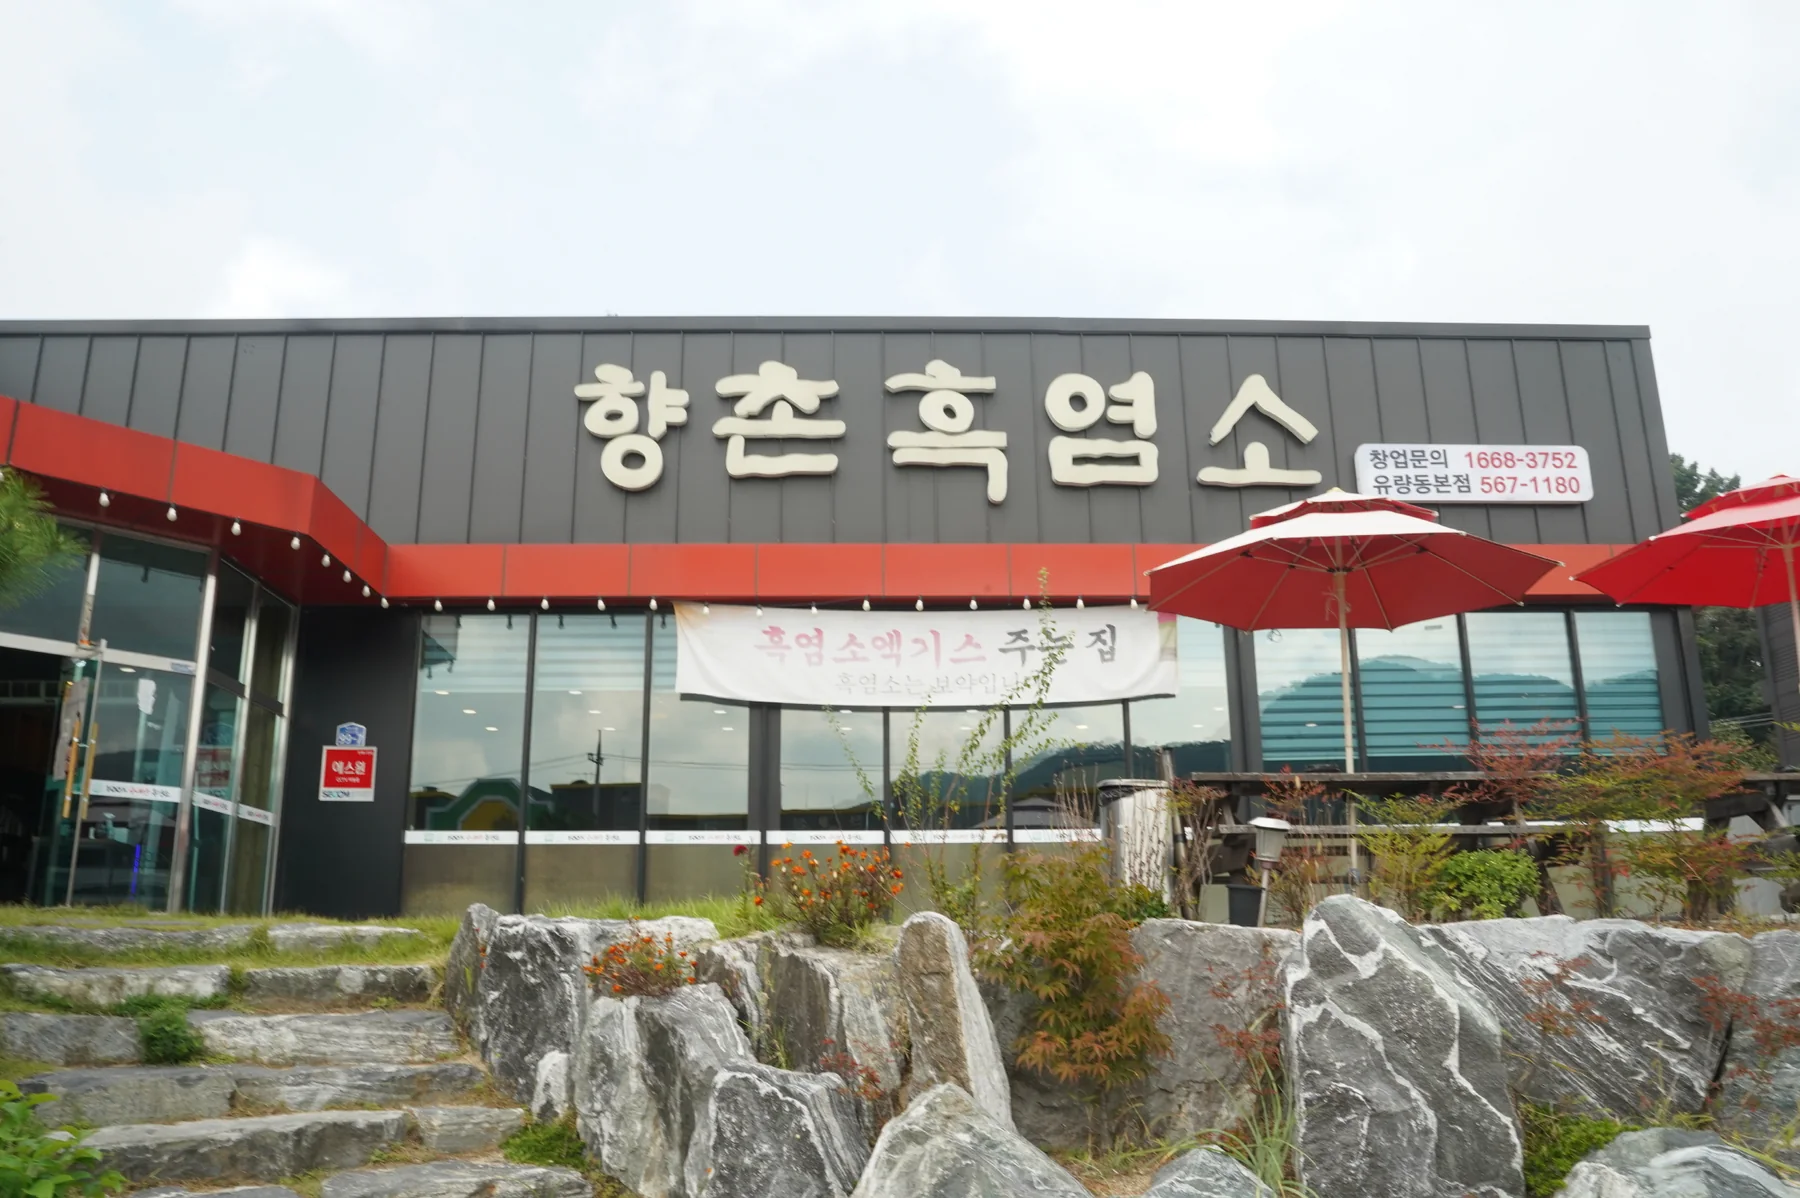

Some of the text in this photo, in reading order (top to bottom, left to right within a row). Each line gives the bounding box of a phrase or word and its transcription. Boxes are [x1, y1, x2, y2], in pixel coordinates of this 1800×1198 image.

[574, 359, 1323, 506] 향촌흑염소
[1369, 448, 1578, 470] 창업문의 1668-3752
[1373, 473, 1581, 495] 유량동본점 567-1180
[1085, 624, 1116, 664] 집
[835, 672, 1044, 696] 흑염소는 보약입니
